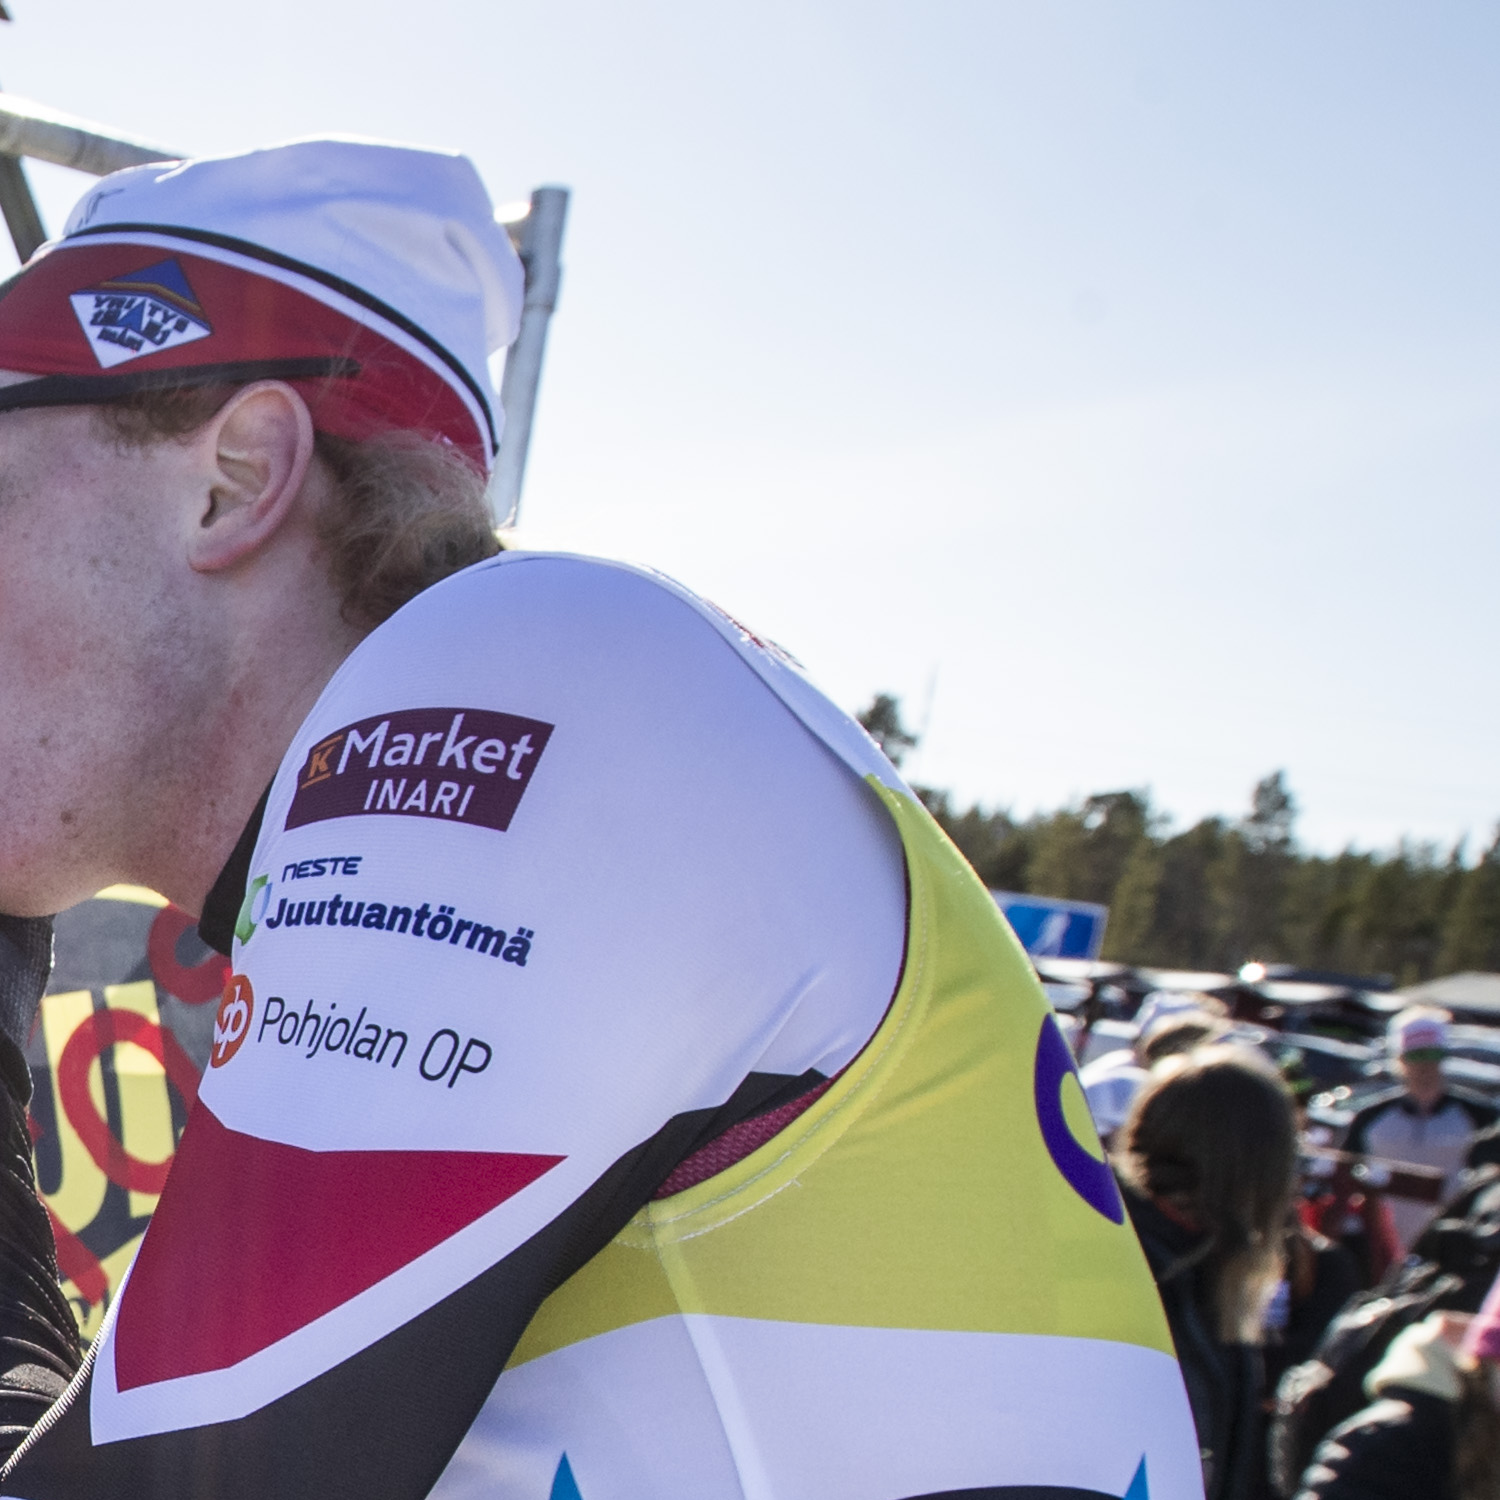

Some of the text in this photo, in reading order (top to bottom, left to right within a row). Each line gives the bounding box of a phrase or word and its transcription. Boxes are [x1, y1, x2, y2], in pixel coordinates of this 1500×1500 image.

[363, 778, 475, 818] INARI
[265, 893, 535, 968] Juutuantörmä
[257, 996, 493, 1089] Pohjolan OP
